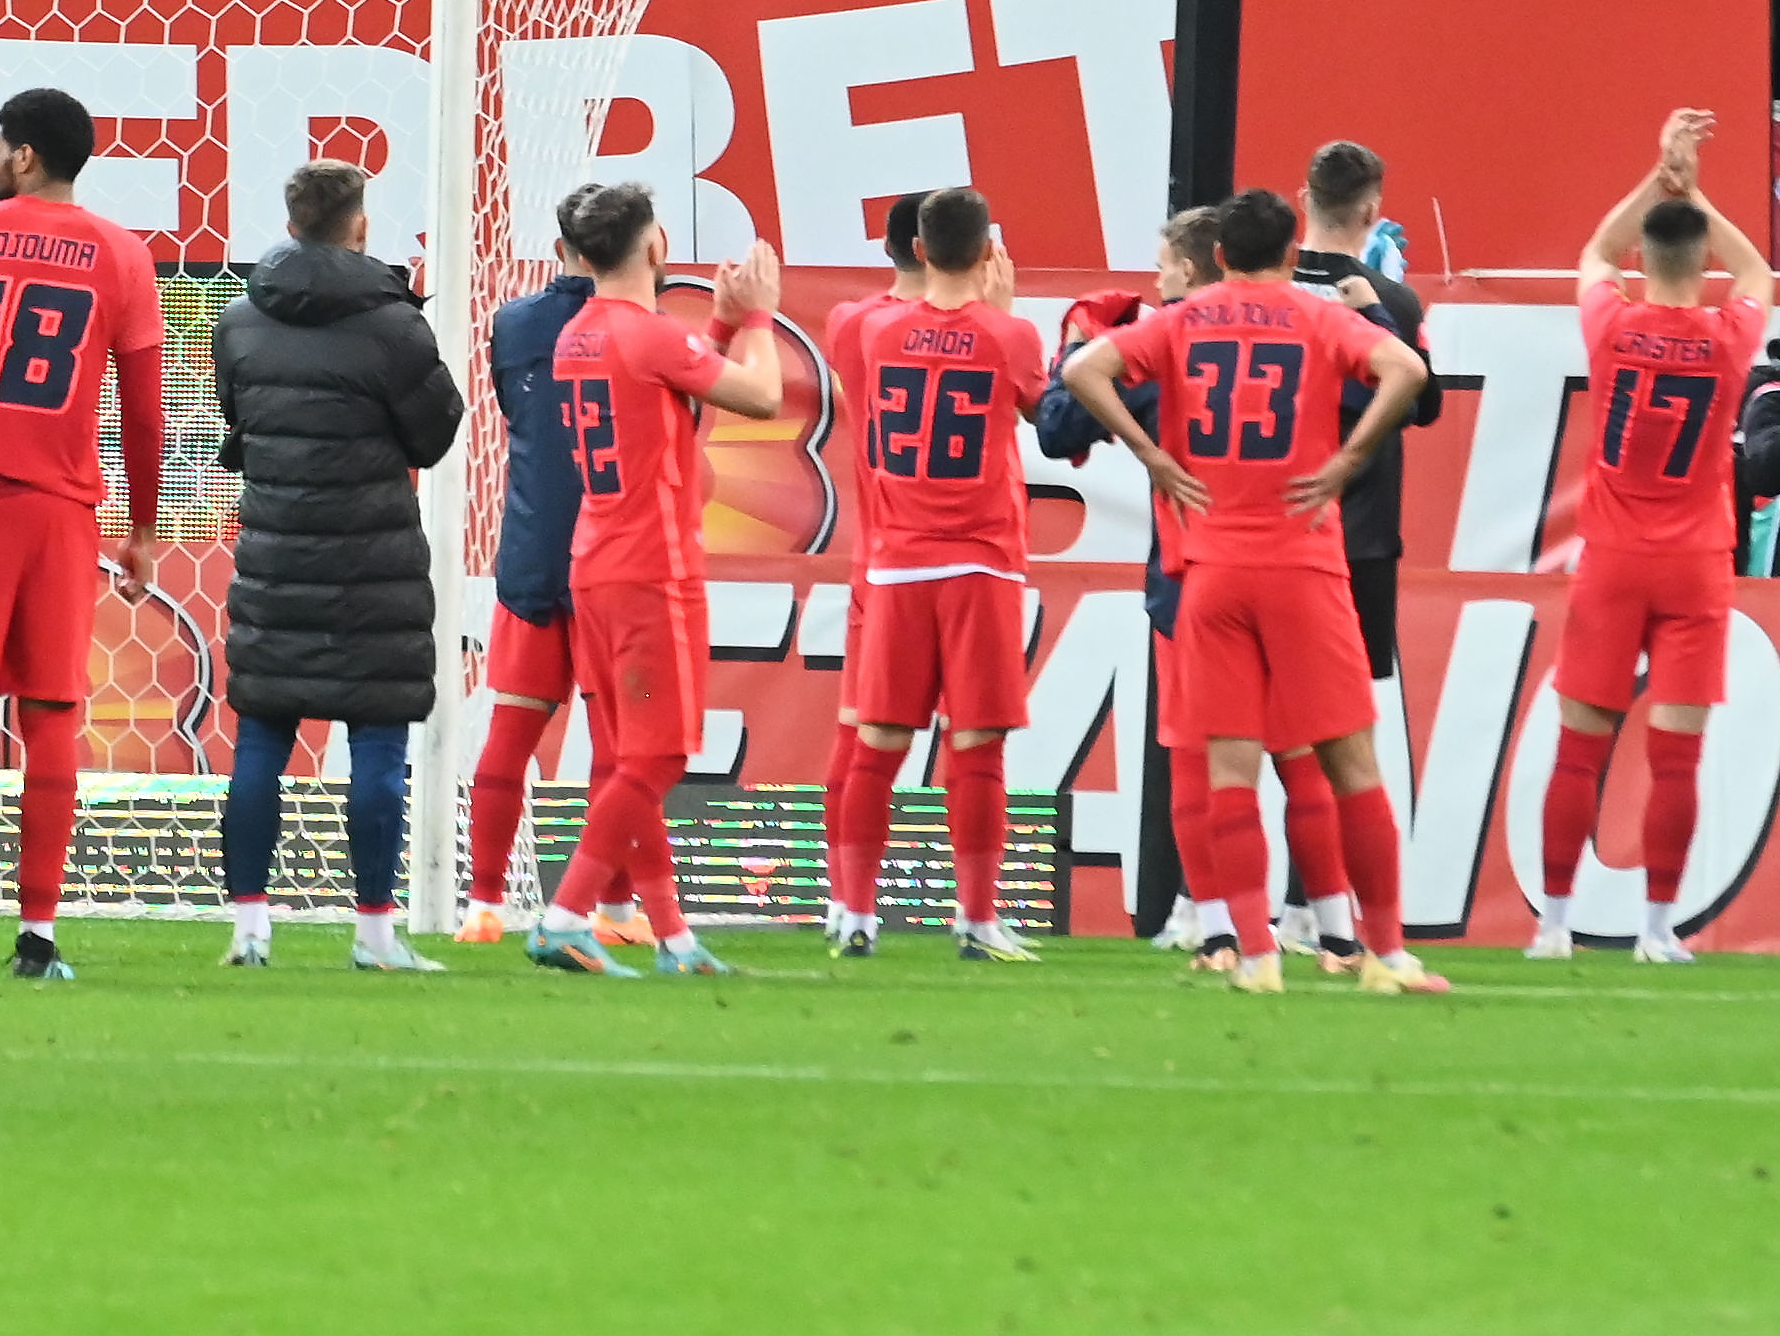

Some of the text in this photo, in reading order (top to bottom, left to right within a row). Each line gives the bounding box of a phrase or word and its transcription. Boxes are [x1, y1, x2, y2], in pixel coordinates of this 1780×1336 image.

[880, 366, 994, 479] 26
[1187, 341, 1304, 460] 33
[1604, 368, 1717, 478] 17
